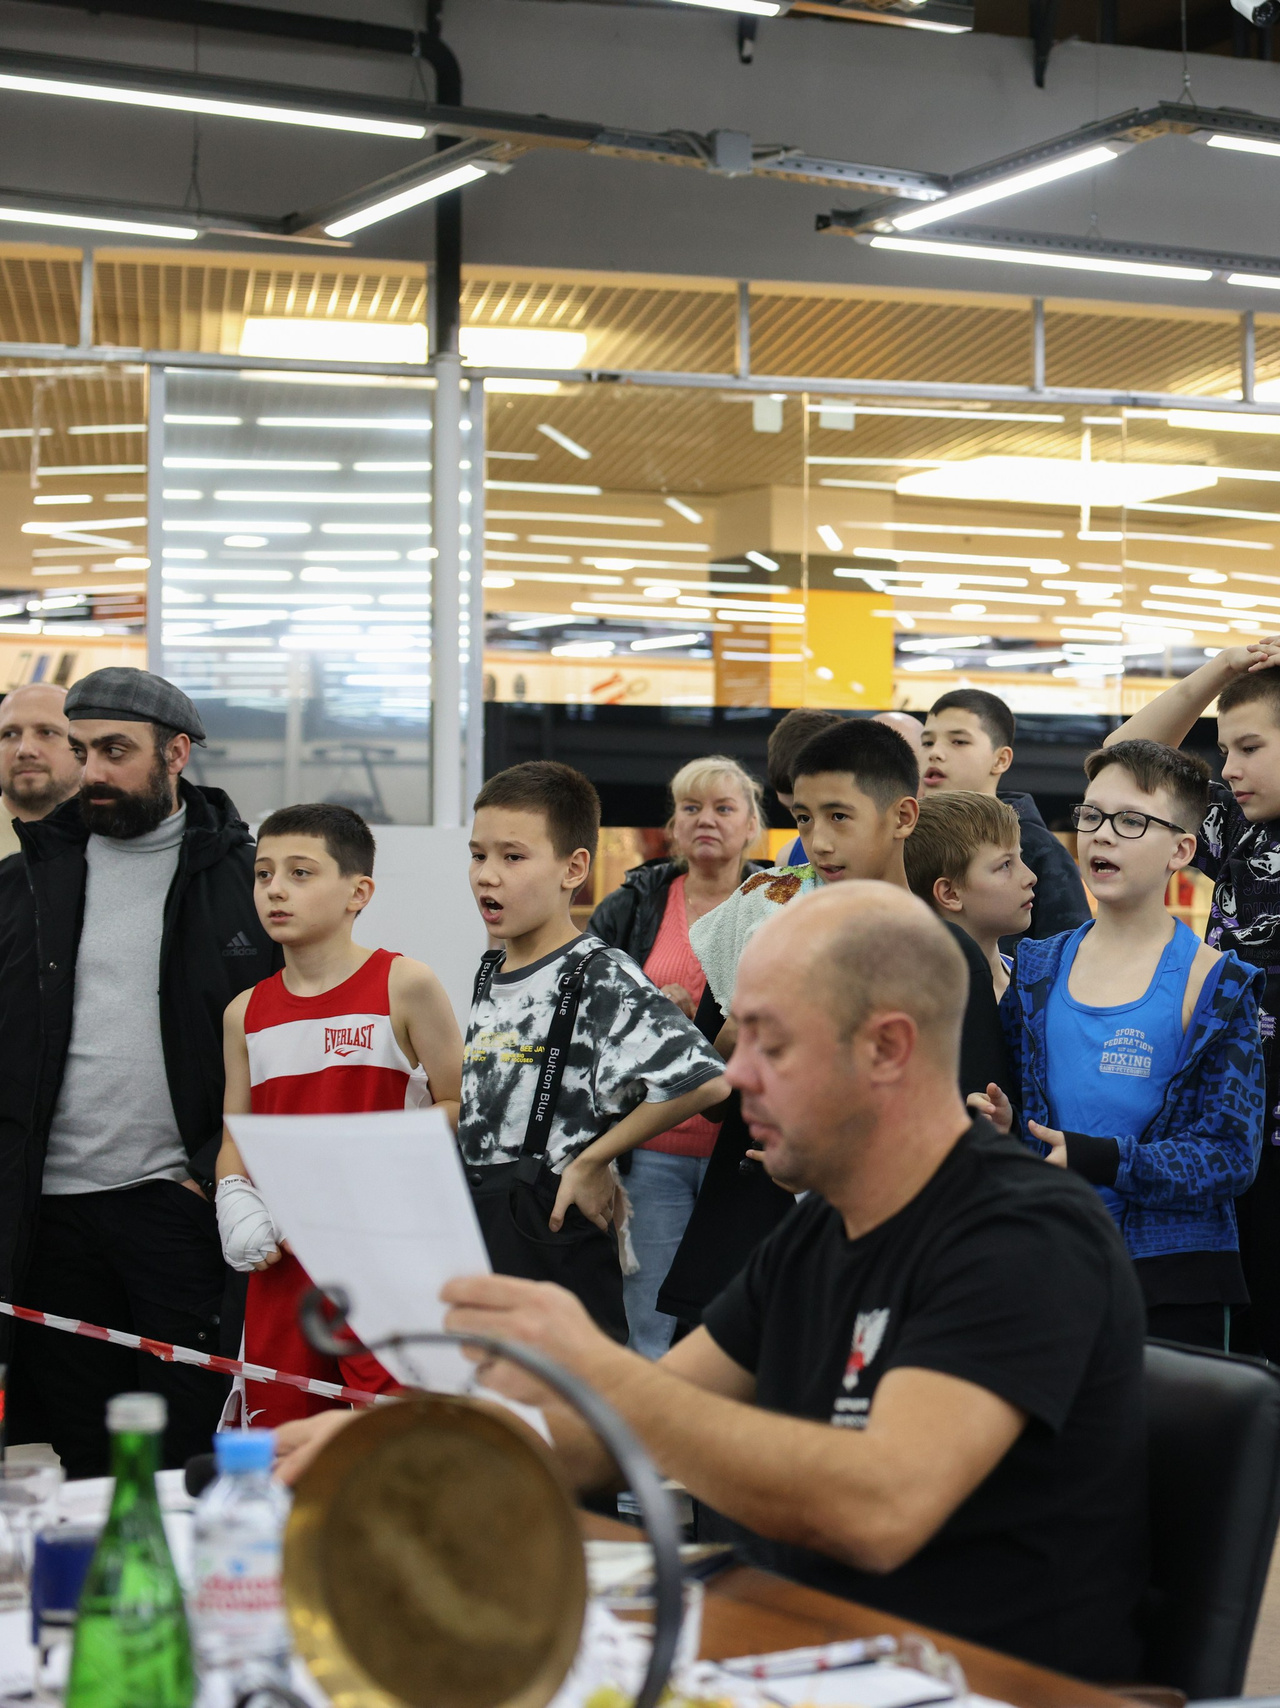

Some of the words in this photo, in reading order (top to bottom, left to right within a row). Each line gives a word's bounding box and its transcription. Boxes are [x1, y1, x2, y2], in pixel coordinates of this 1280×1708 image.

[222, 947, 257, 957] adidas
[476, 962, 492, 997] Butto
[324, 1023, 375, 1054] EVERLAST
[1115, 1028, 1145, 1039] SPORTS
[1103, 1037, 1154, 1054] FEDERATION
[542, 1047, 560, 1090] Button
[1101, 1052, 1151, 1068] BOXING
[535, 1092, 551, 1122] Blue
